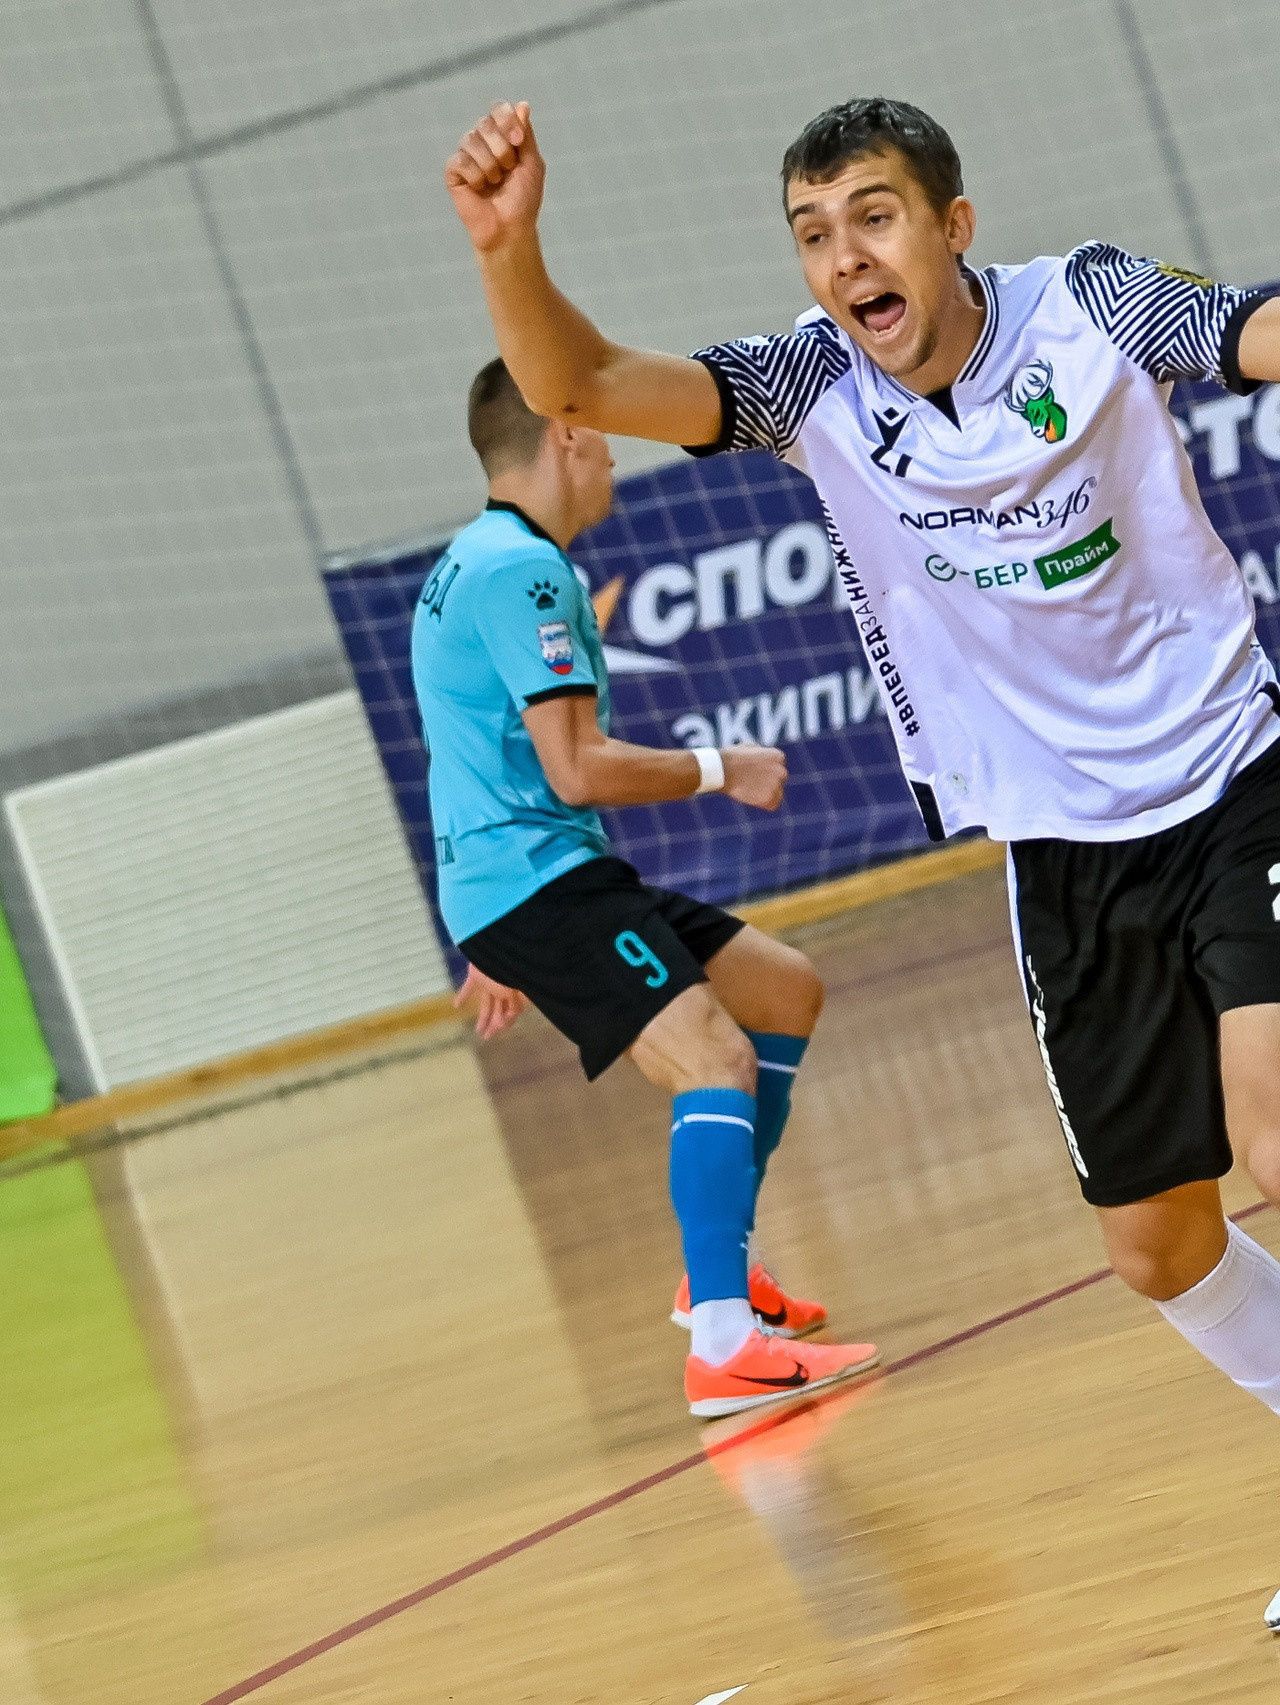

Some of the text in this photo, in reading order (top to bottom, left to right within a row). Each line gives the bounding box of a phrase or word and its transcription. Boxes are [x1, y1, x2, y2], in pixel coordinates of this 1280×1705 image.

[627, 521, 851, 647] спо
[958, 540, 1110, 590] БЕР Прайм
[615, 929, 669, 990] 9
